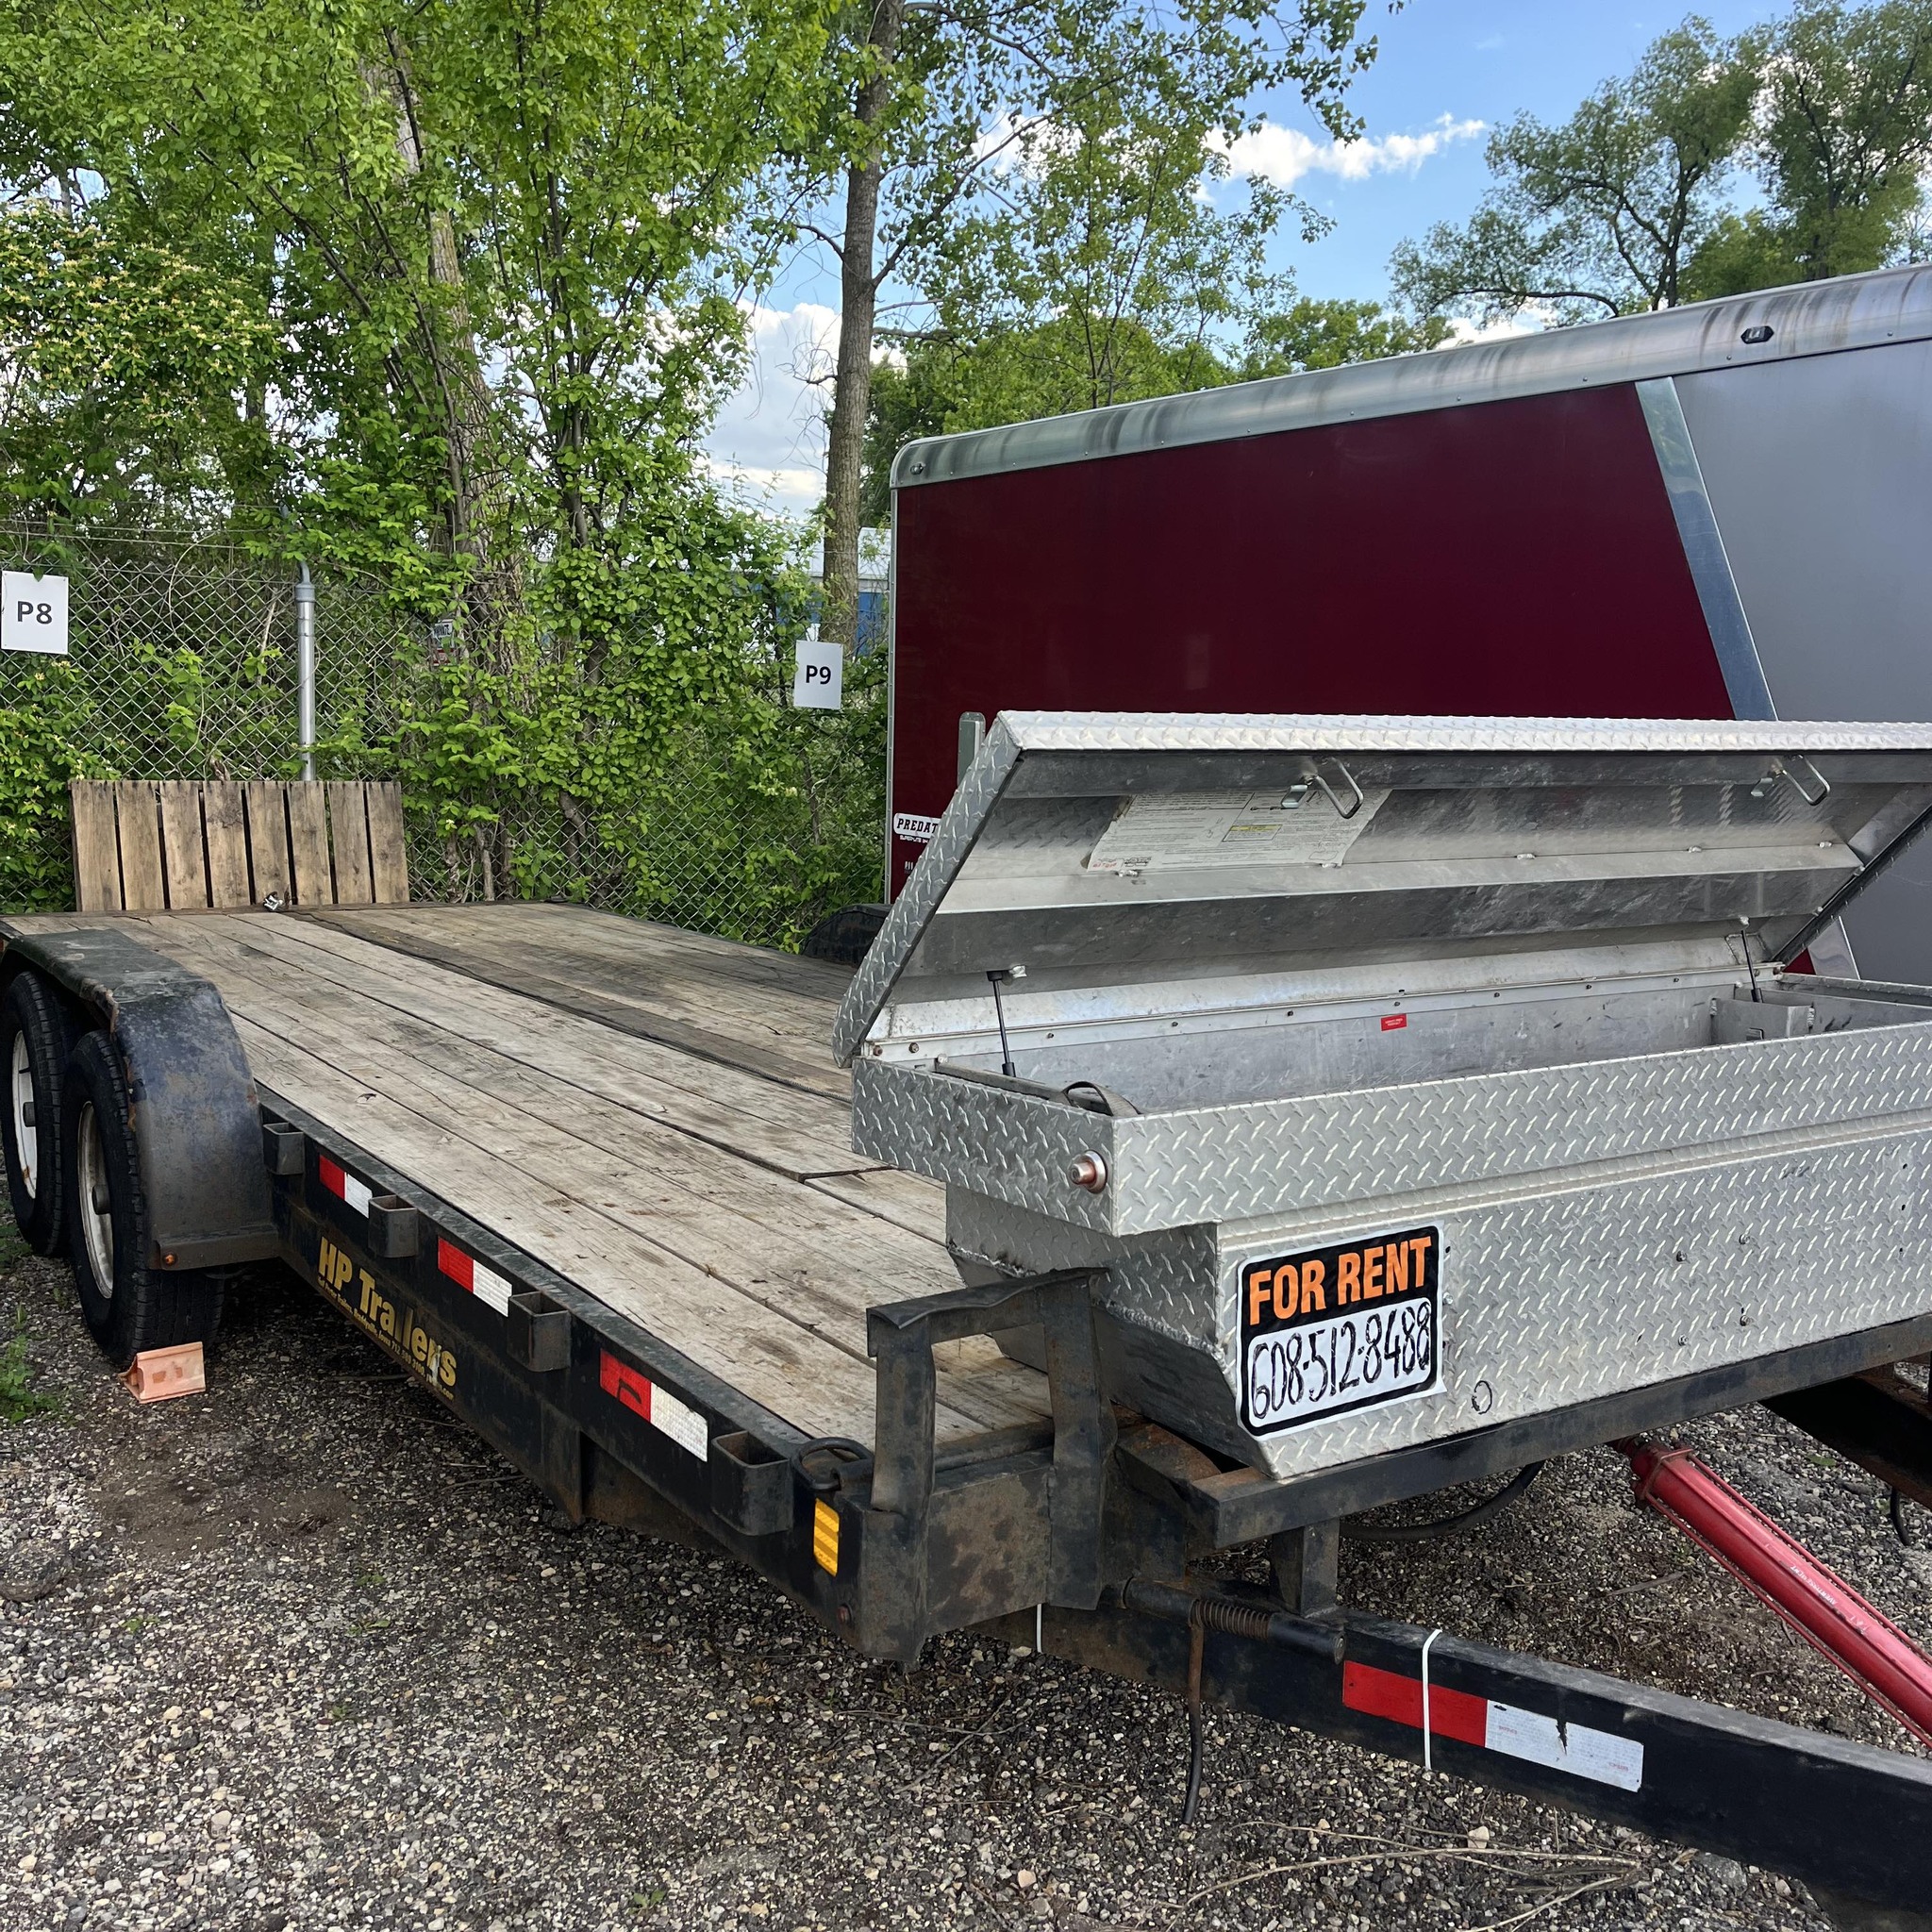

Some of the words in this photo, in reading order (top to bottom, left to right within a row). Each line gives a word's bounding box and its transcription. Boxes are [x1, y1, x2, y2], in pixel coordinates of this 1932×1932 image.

[17, 600, 53, 625] P8
[806, 664, 832, 685] P9
[318, 1236, 353, 1291] HP
[1249, 1259, 1326, 1325] FOR
[1338, 1236, 1432, 1306] RENT
[1251, 1301, 1432, 1419] 608-512-8488
